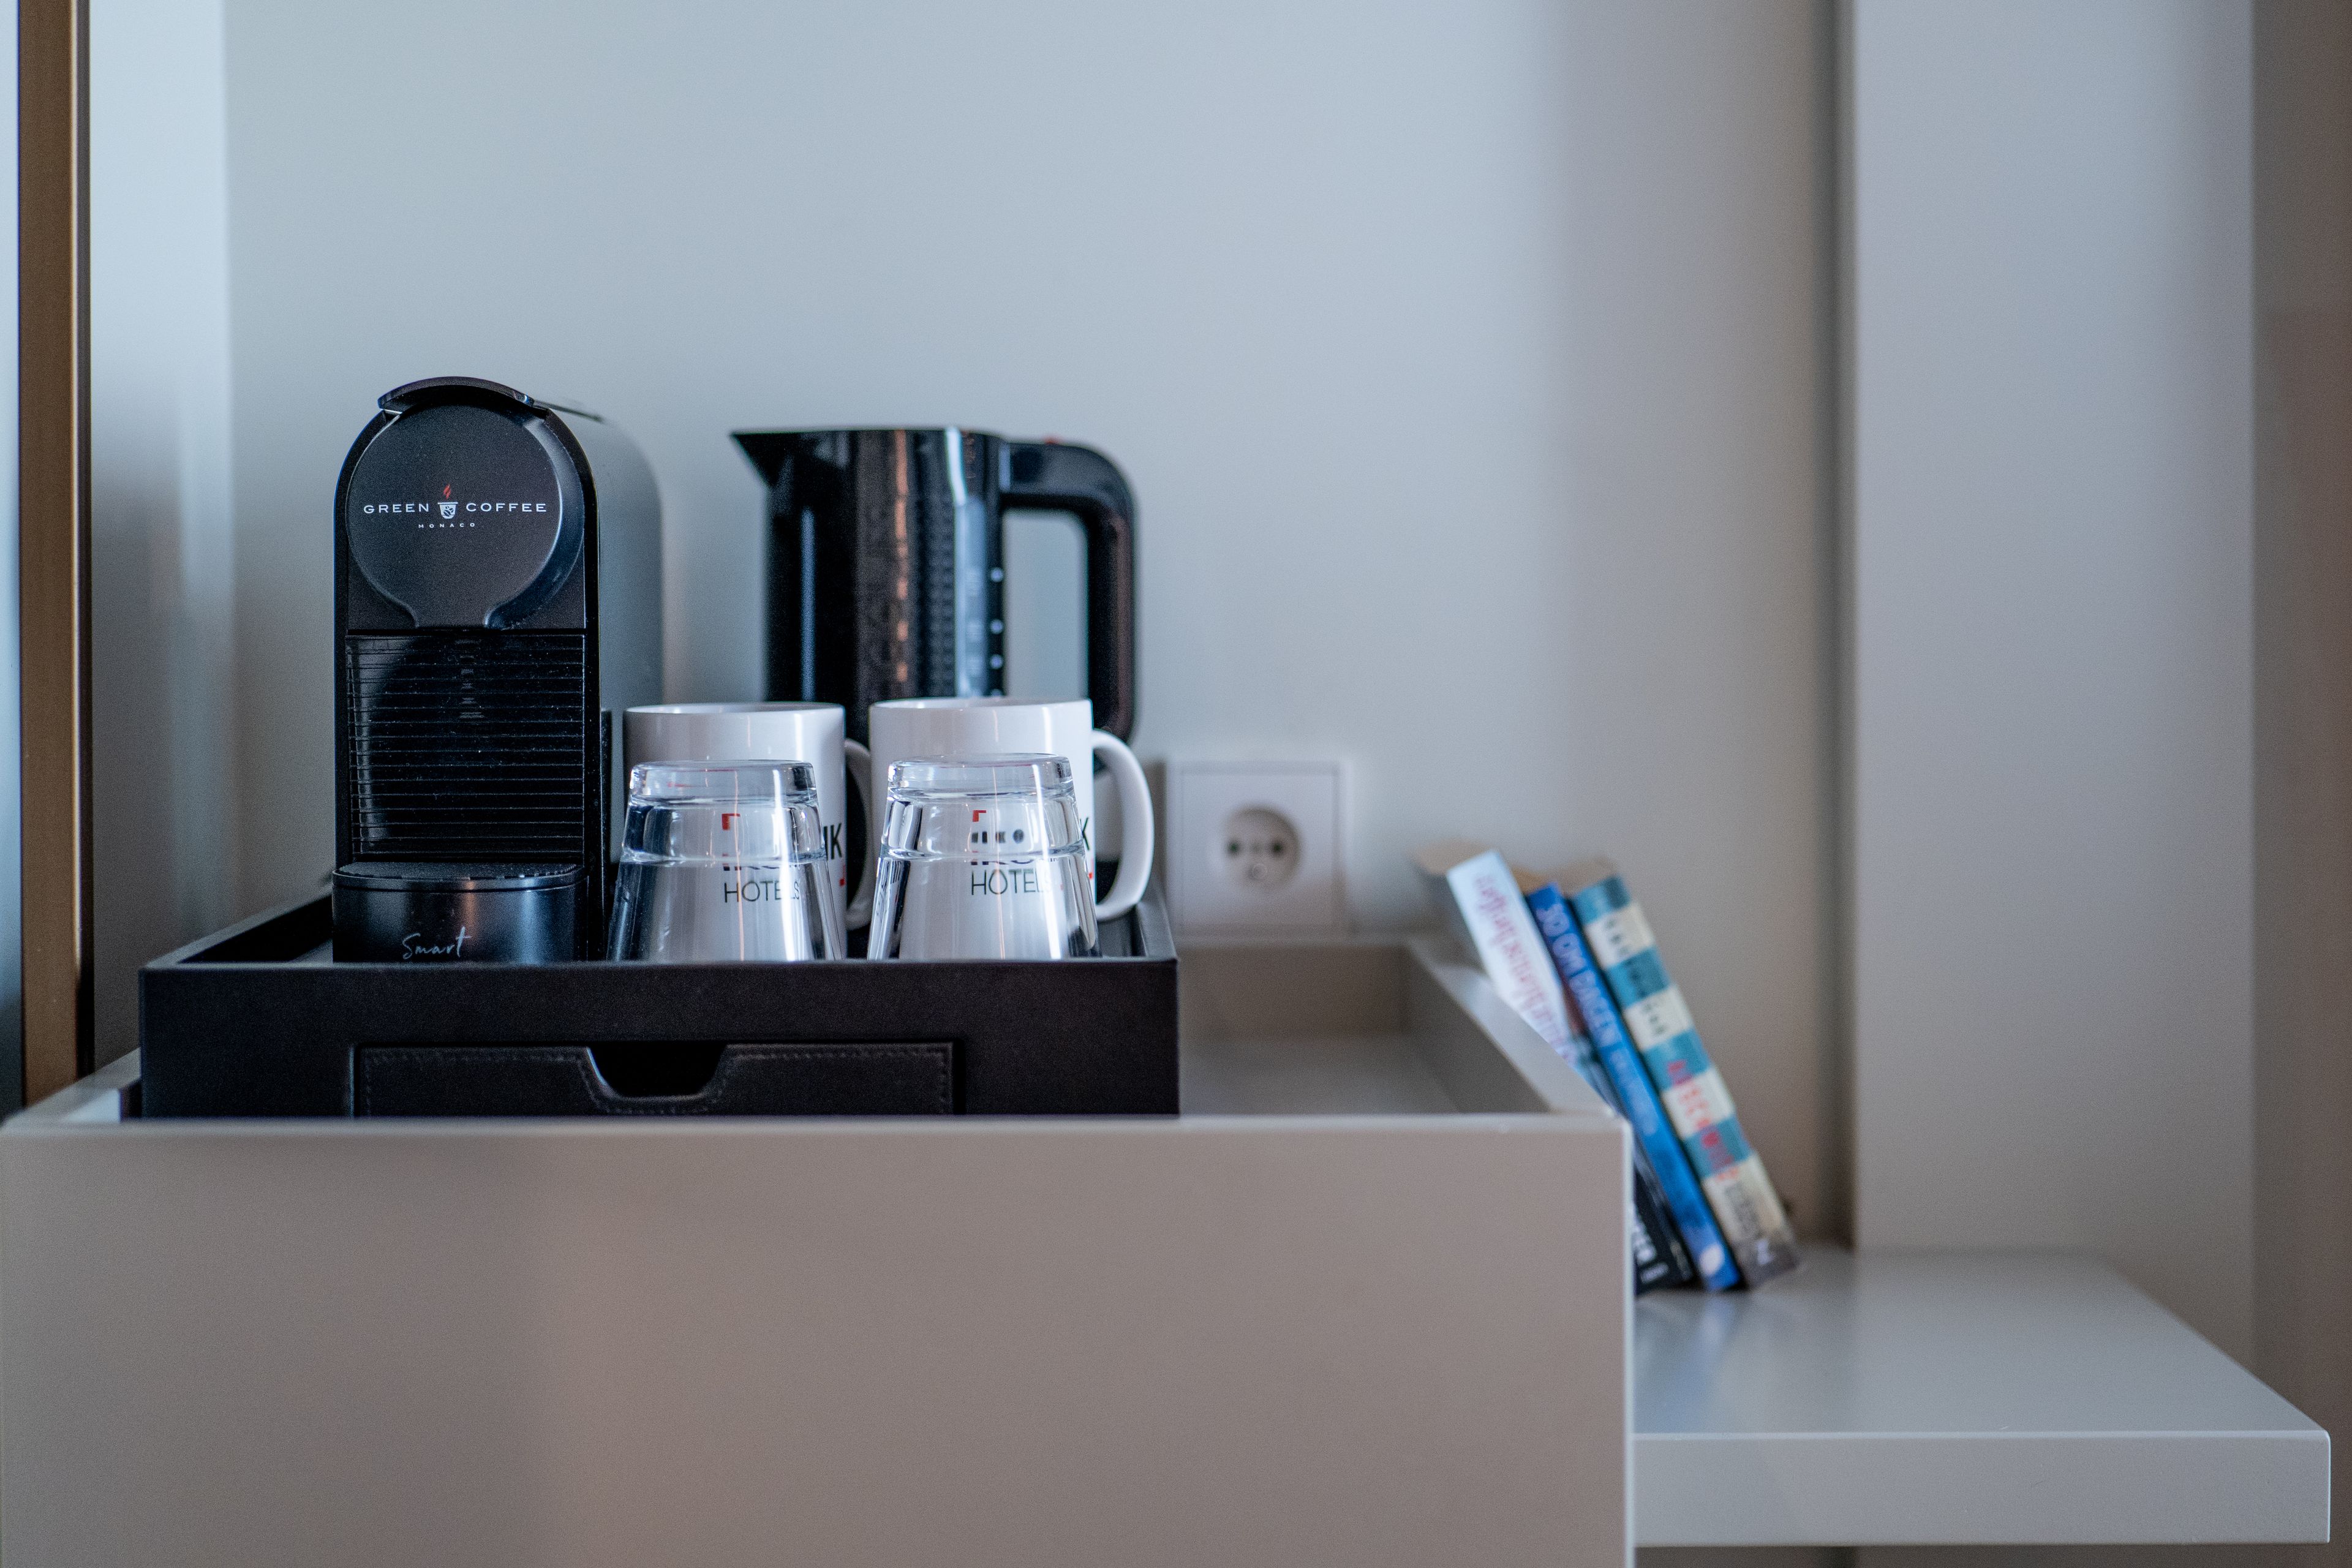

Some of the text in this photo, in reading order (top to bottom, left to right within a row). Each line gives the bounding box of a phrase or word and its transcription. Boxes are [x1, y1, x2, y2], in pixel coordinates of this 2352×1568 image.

[363, 502, 547, 514] GREEN COFFEE
[402, 926, 471, 959] Smart
